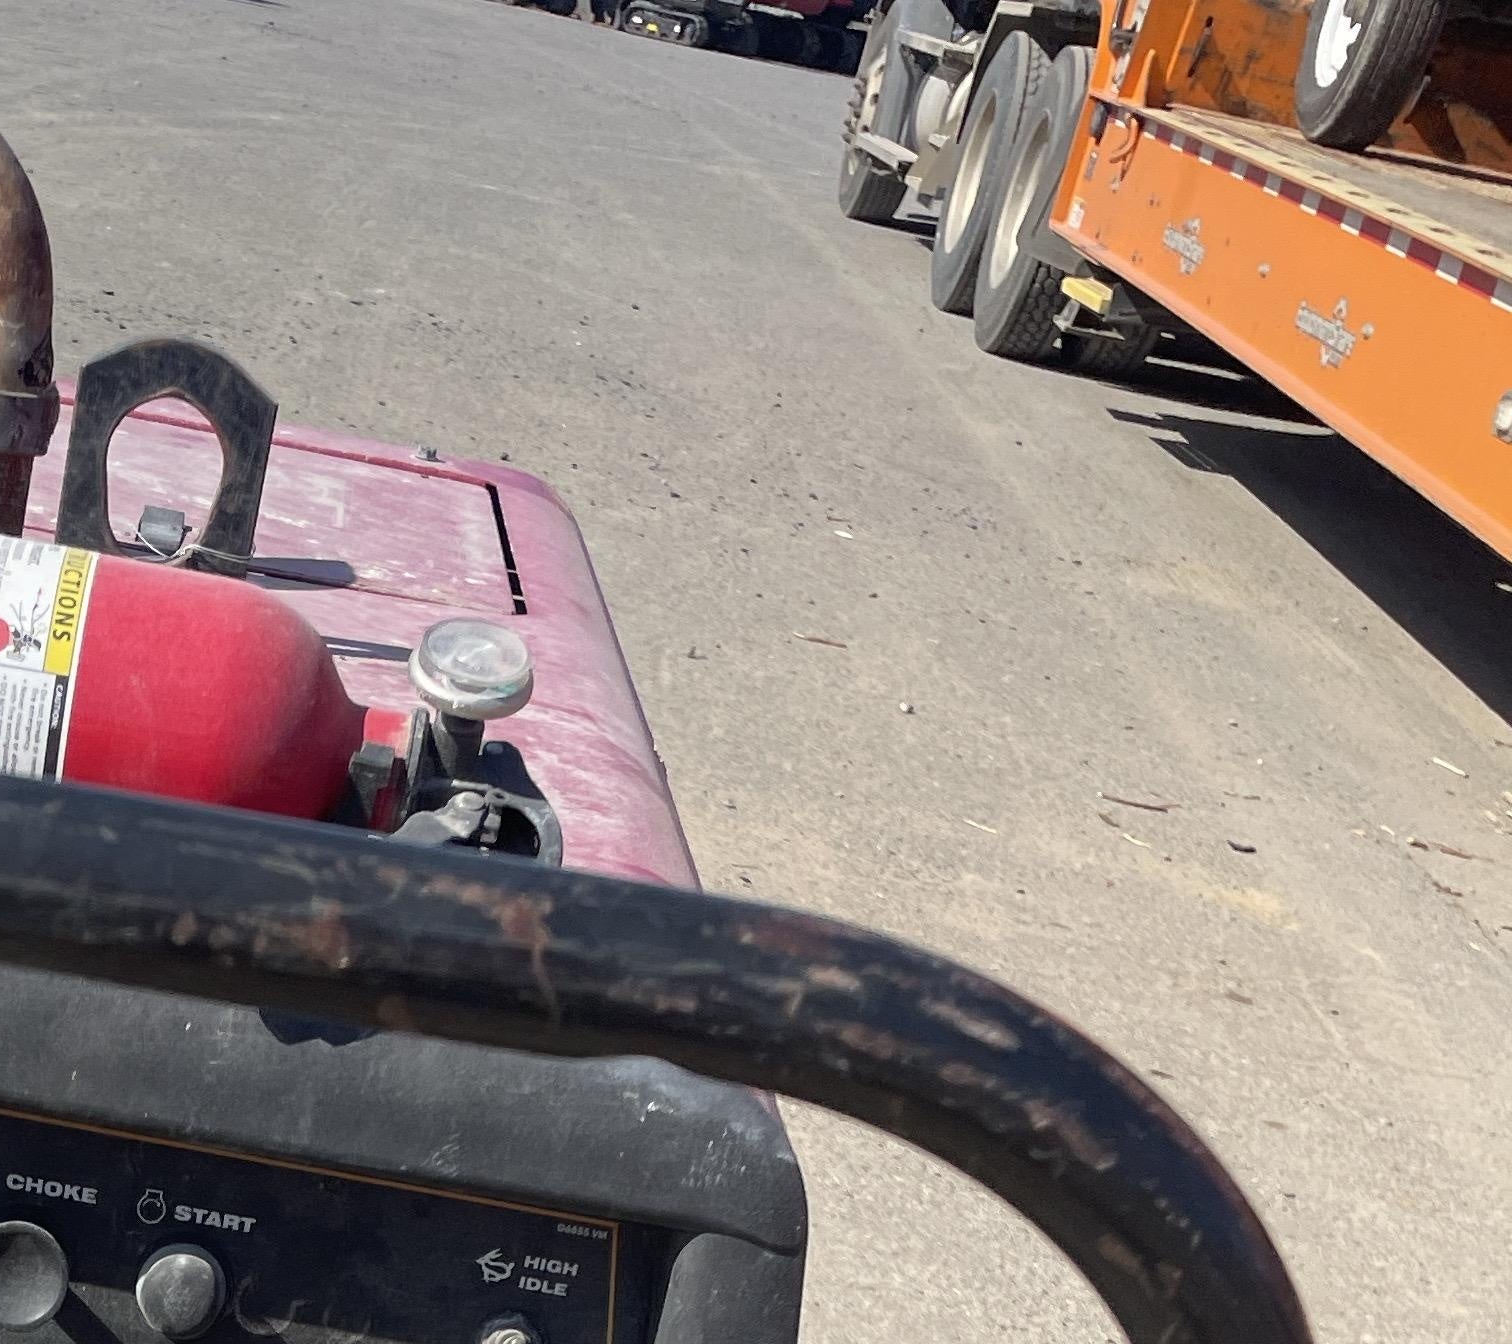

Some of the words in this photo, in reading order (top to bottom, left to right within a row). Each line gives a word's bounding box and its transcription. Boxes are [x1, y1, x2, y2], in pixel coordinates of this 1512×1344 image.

[6, 1173, 99, 1205] CHOKE
[174, 1204, 256, 1234] START
[523, 1255, 579, 1277] HIGH
[518, 1275, 568, 1297] IDLE
